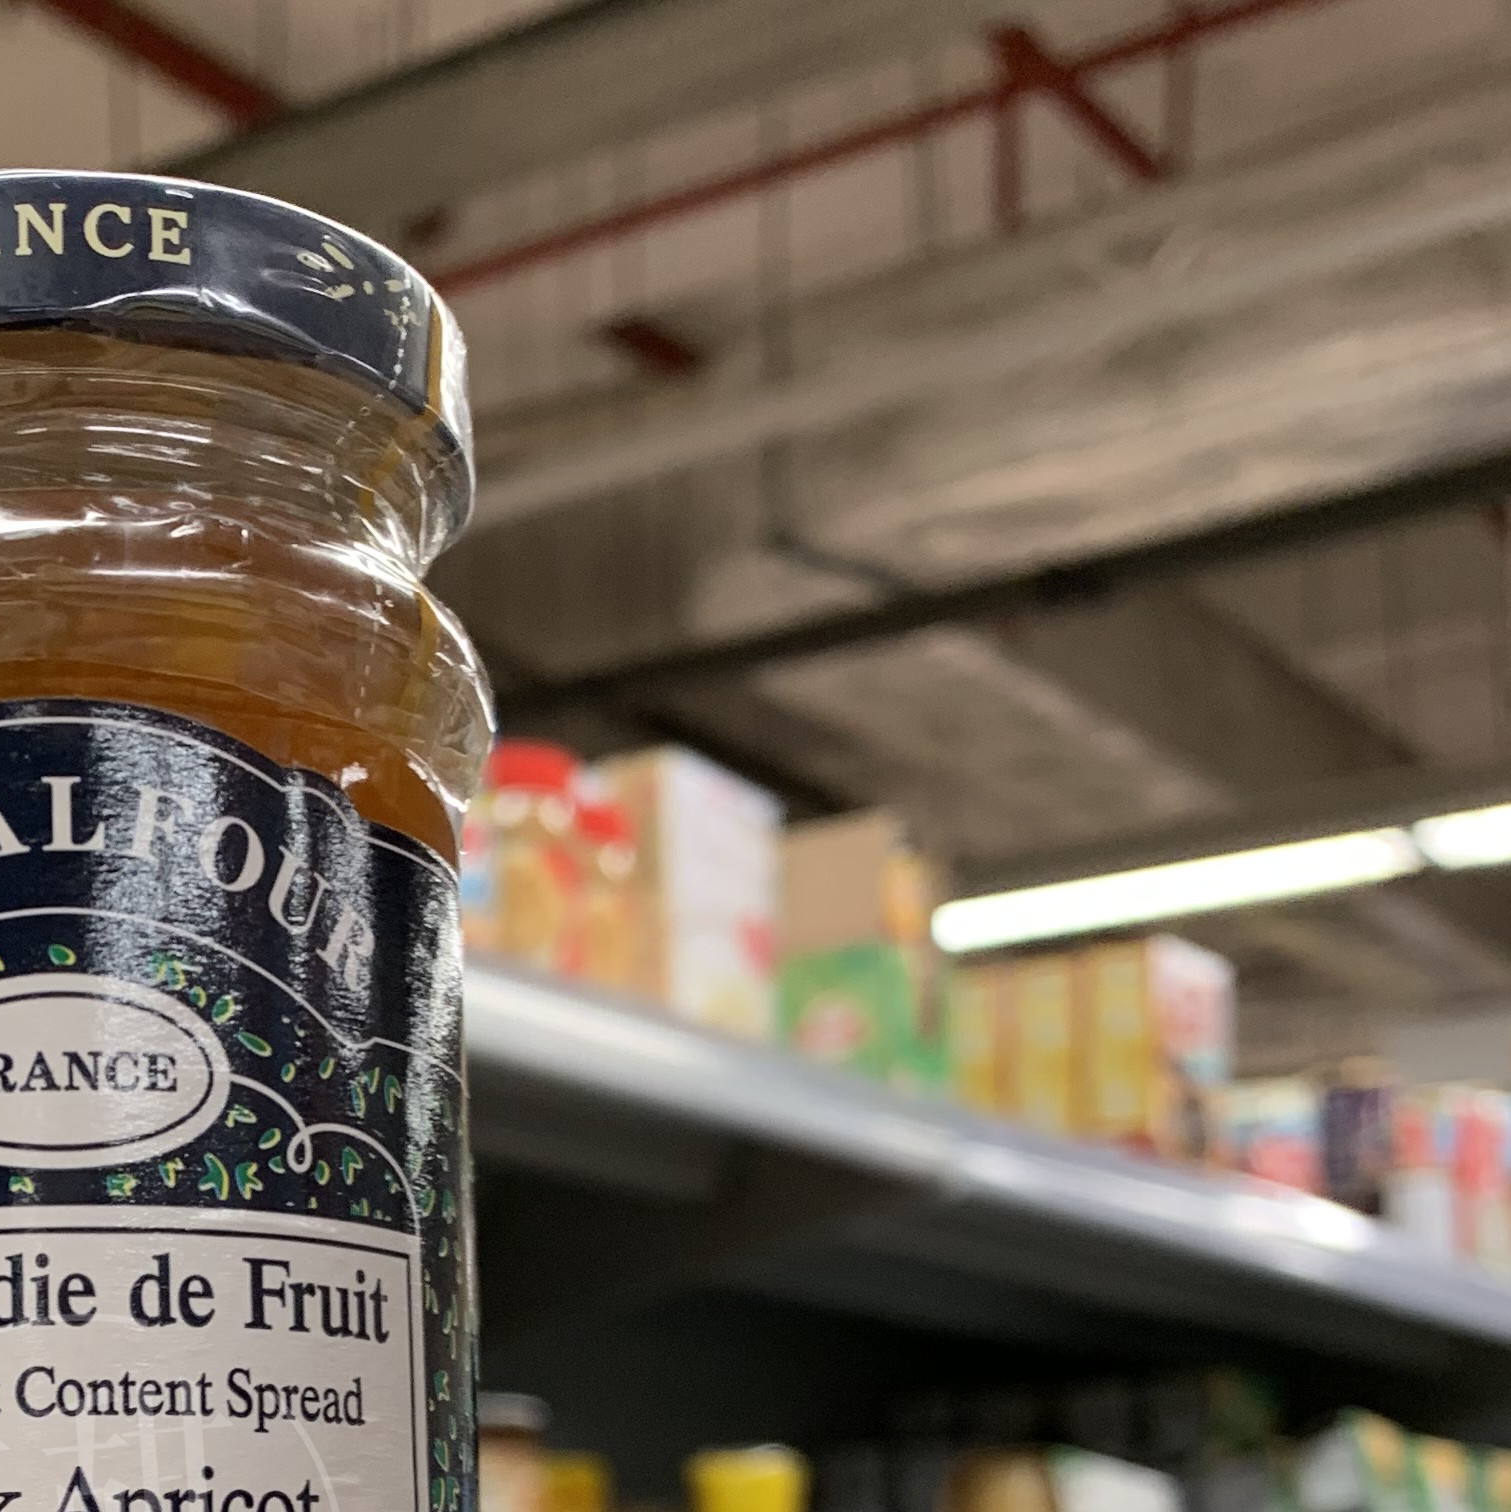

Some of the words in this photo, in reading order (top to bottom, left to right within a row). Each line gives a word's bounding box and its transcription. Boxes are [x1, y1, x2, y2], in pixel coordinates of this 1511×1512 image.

[129, 1253, 216, 1328] de
[242, 1256, 390, 1345] Fruit
[14, 1366, 216, 1419] Content
[226, 1367, 367, 1434] Spread
